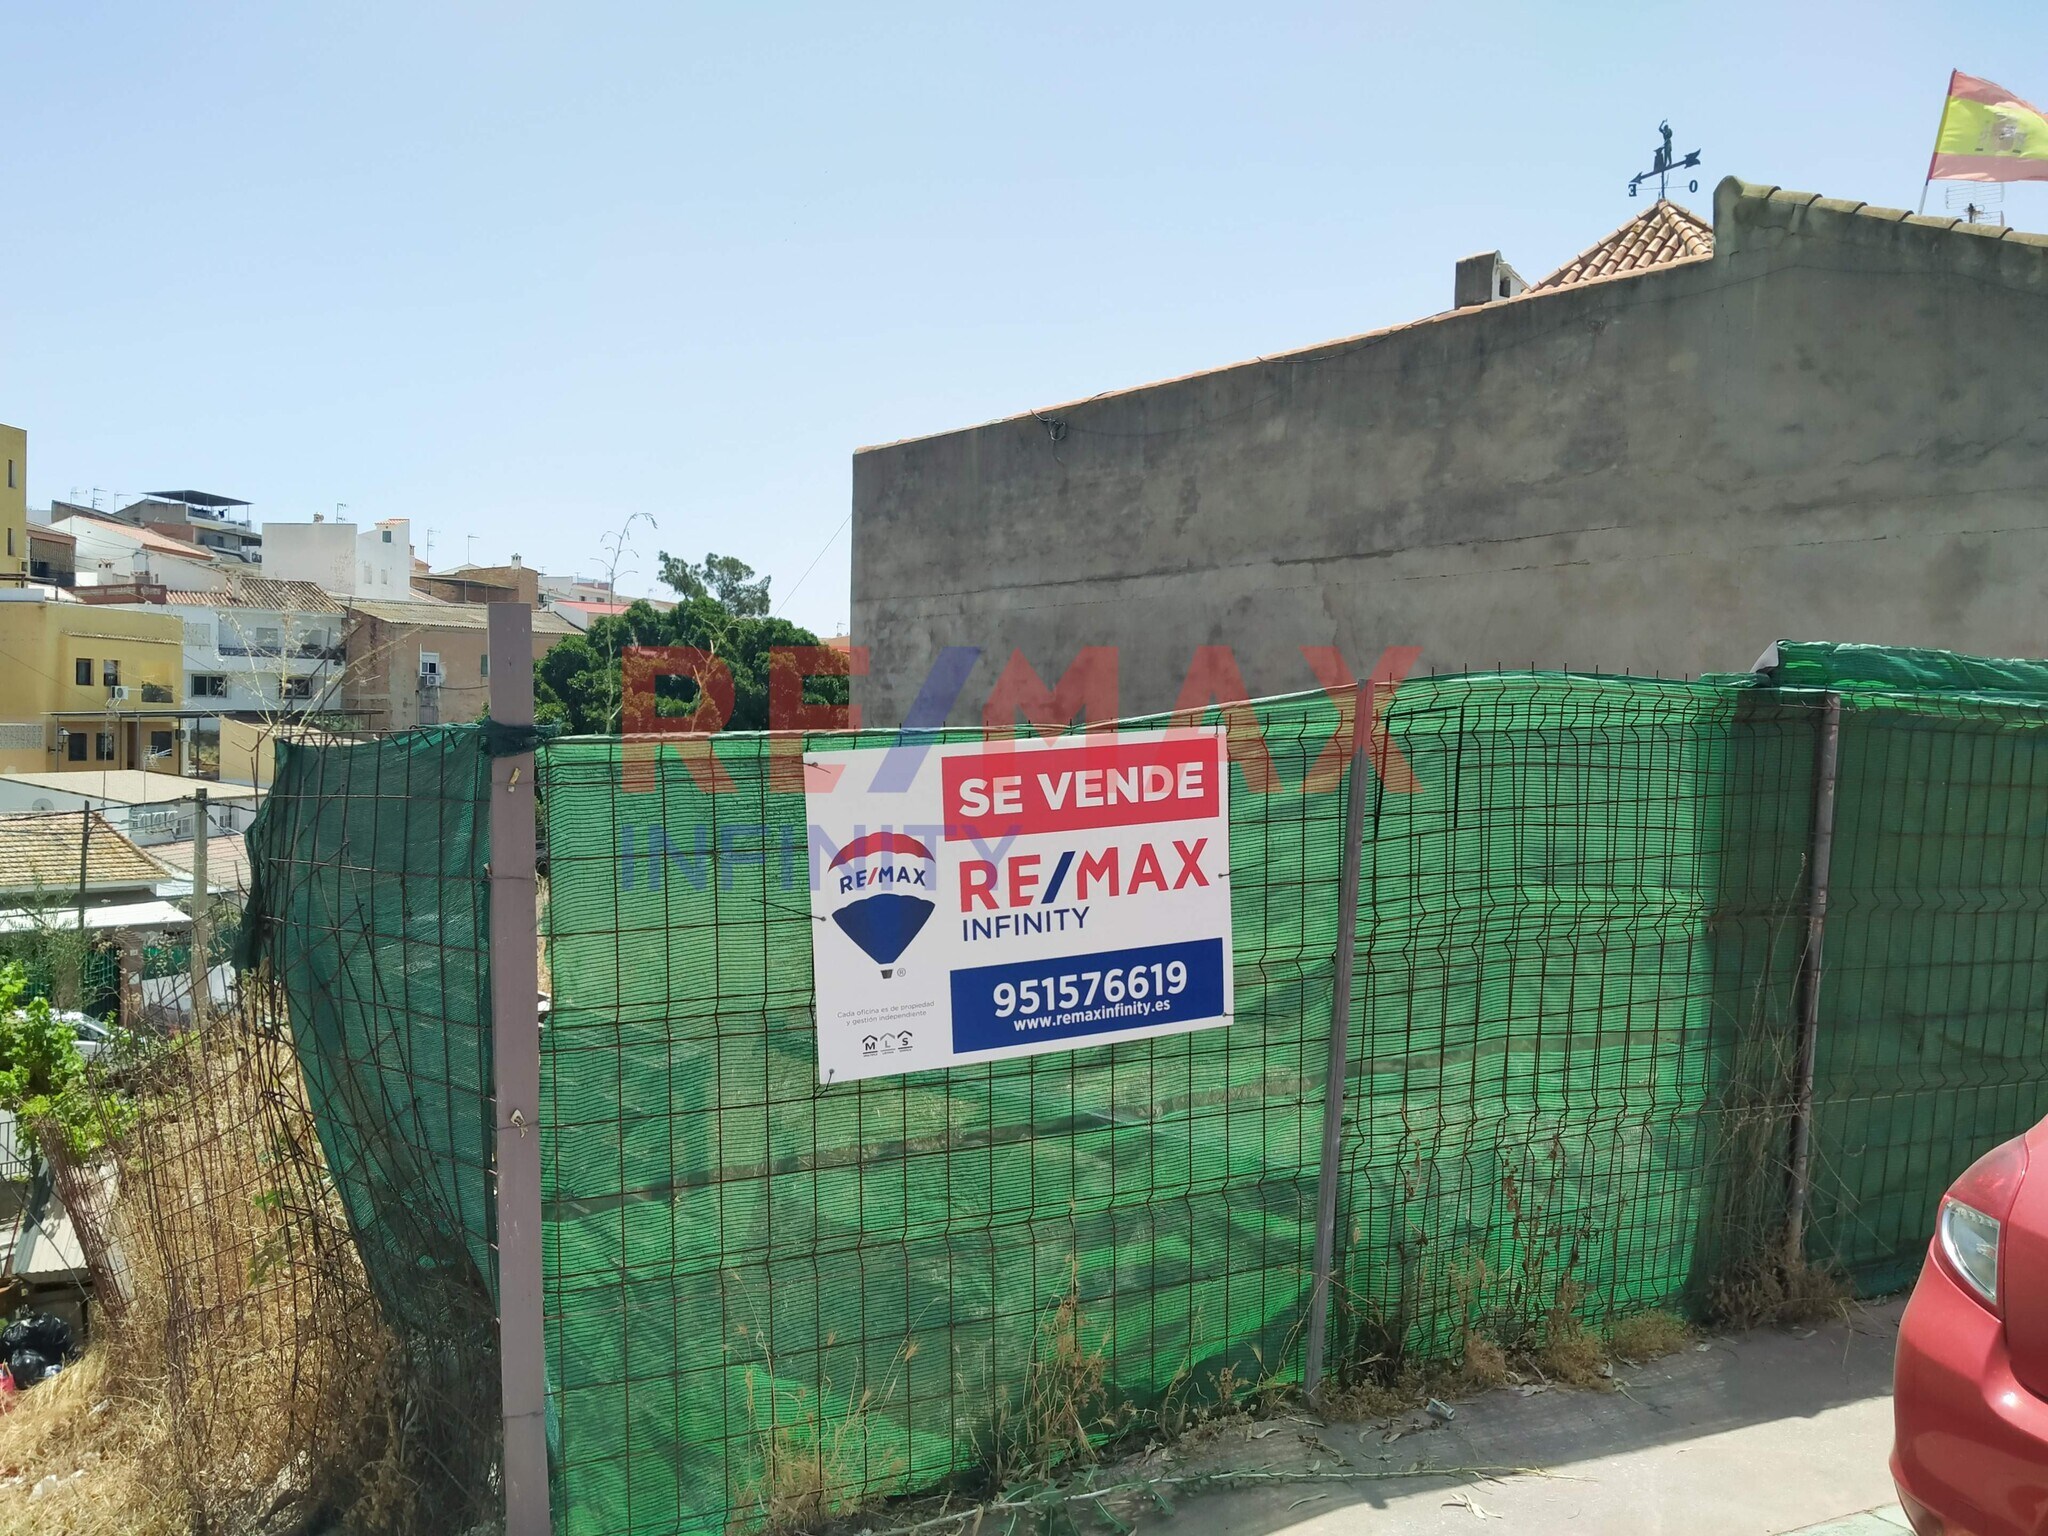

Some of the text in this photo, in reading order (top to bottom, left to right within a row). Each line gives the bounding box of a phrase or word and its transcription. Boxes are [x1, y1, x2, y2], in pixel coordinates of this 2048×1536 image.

[958, 761, 1205, 818] SE VENDE
[840, 865, 927, 895] RE/MAX
[959, 838, 1210, 913] RE/MAX
[962, 906, 1091, 942] INFINITY
[992, 961, 1188, 1018] 951576619
[837, 1009, 855, 1019] Cada
[857, 1007, 879, 1016] oficina
[900, 1000, 935, 1011] propiedad
[852, 1014, 878, 1025] gestión
[879, 1009, 927, 1021] independiente
[1013, 999, 1171, 1032] www.remaxinfinity.es
